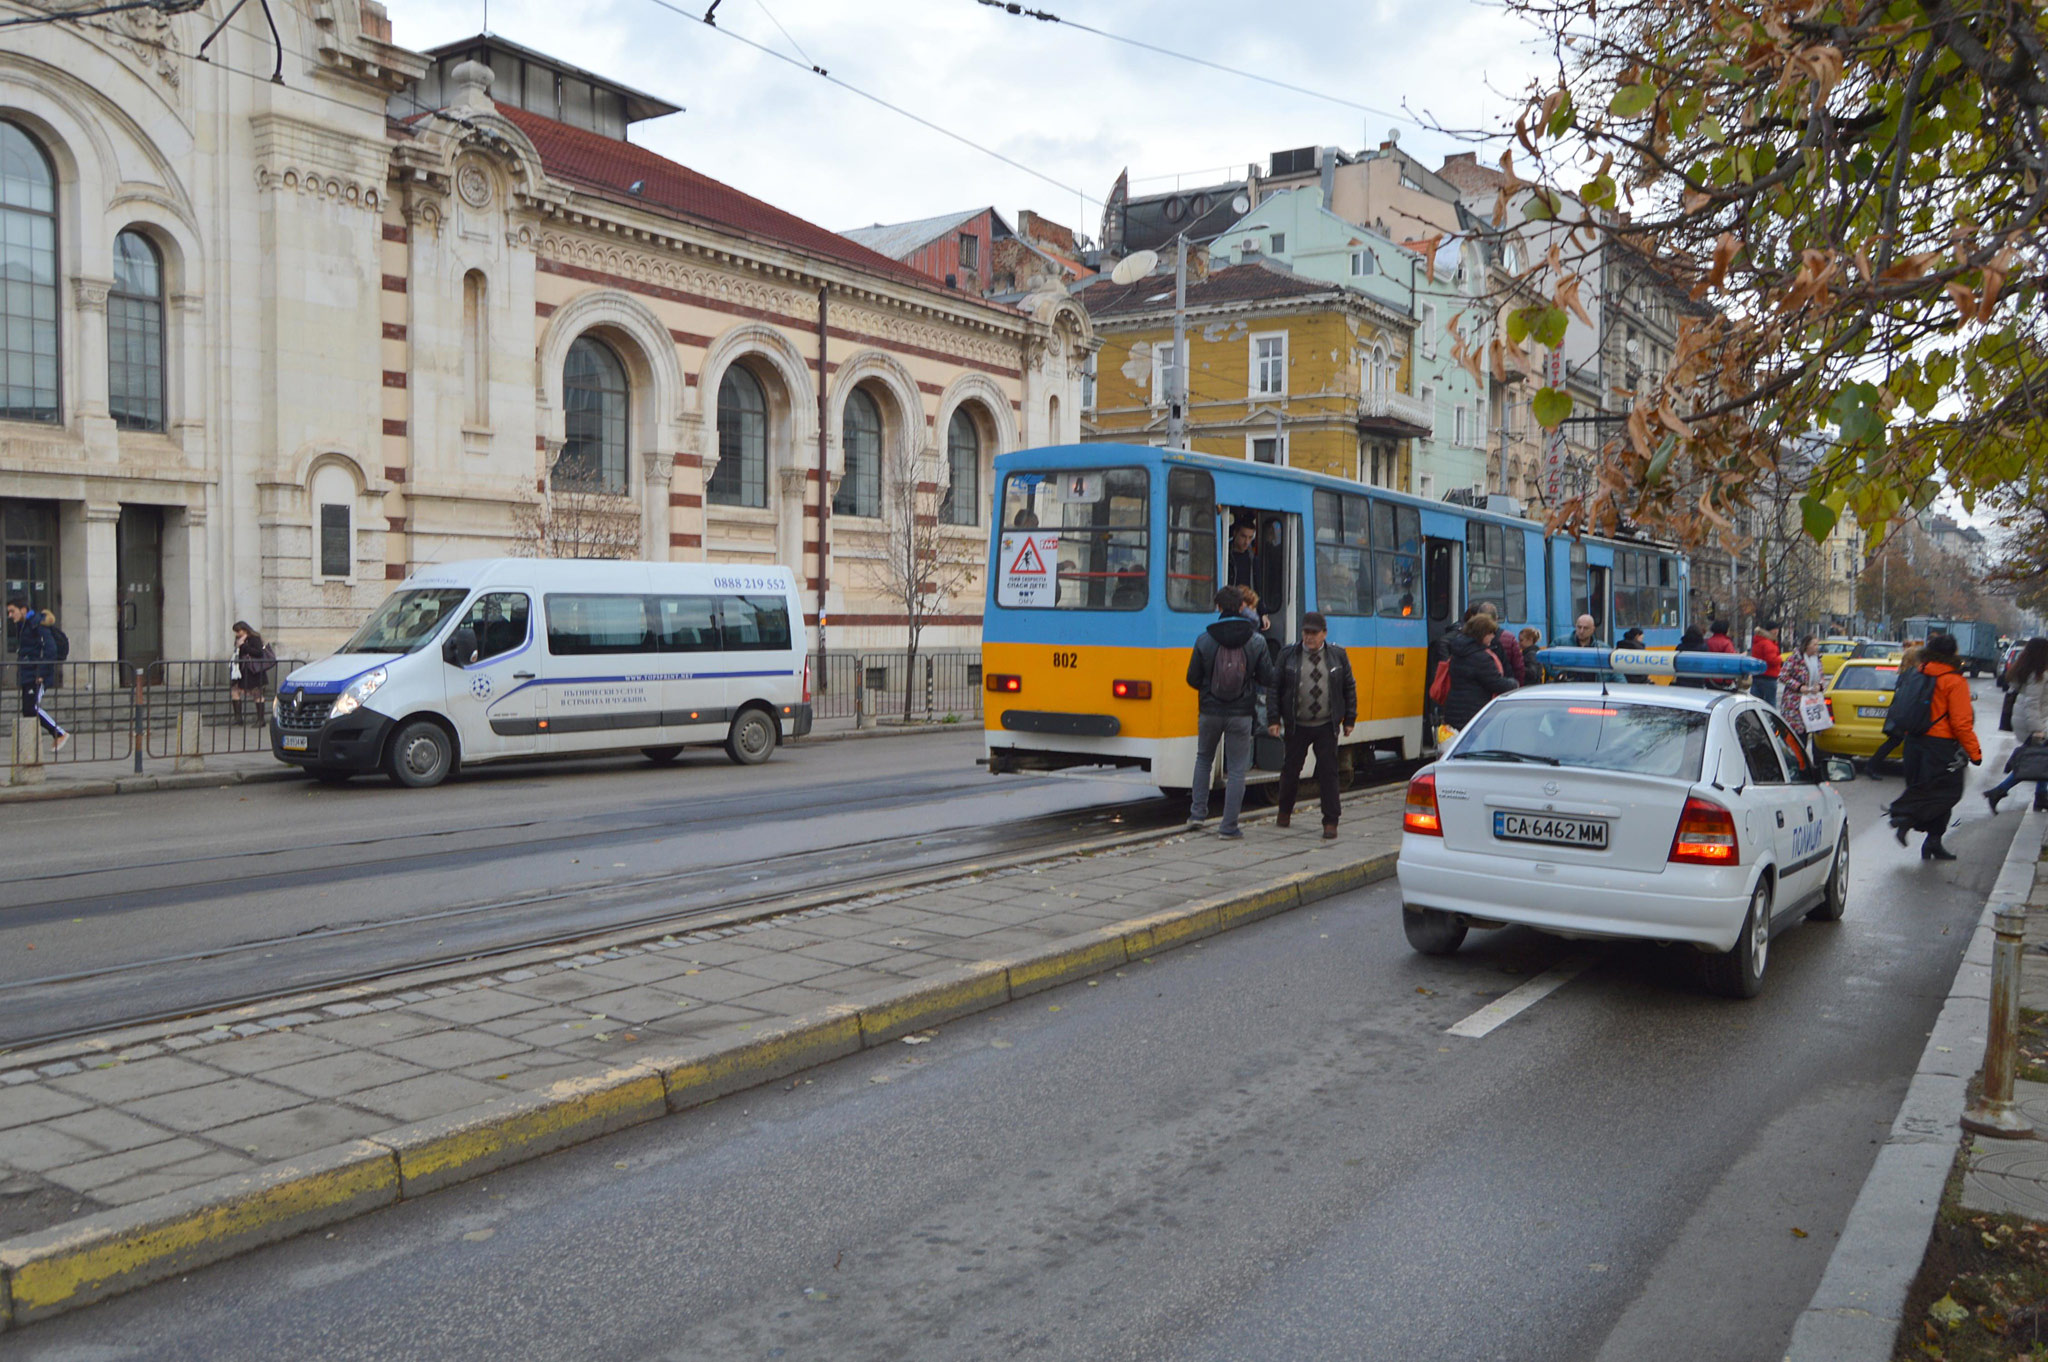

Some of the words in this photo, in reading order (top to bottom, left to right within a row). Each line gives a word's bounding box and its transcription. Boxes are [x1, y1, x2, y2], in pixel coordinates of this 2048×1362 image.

[1073, 477, 1085, 497] 4
[714, 577, 741, 589] 0888
[744, 578, 763, 590] 219
[767, 578, 785, 590] 552
[1053, 652, 1077, 669] 802
[1614, 653, 1669, 665] POLICE
[566, 698, 604, 706] СТРАНАТА
[1506, 817, 1529, 835] CA
[1532, 820, 1575, 840] 6462
[1579, 824, 1603, 842] MM
[1792, 818, 1822, 858] ПОЛИЦИЯ
